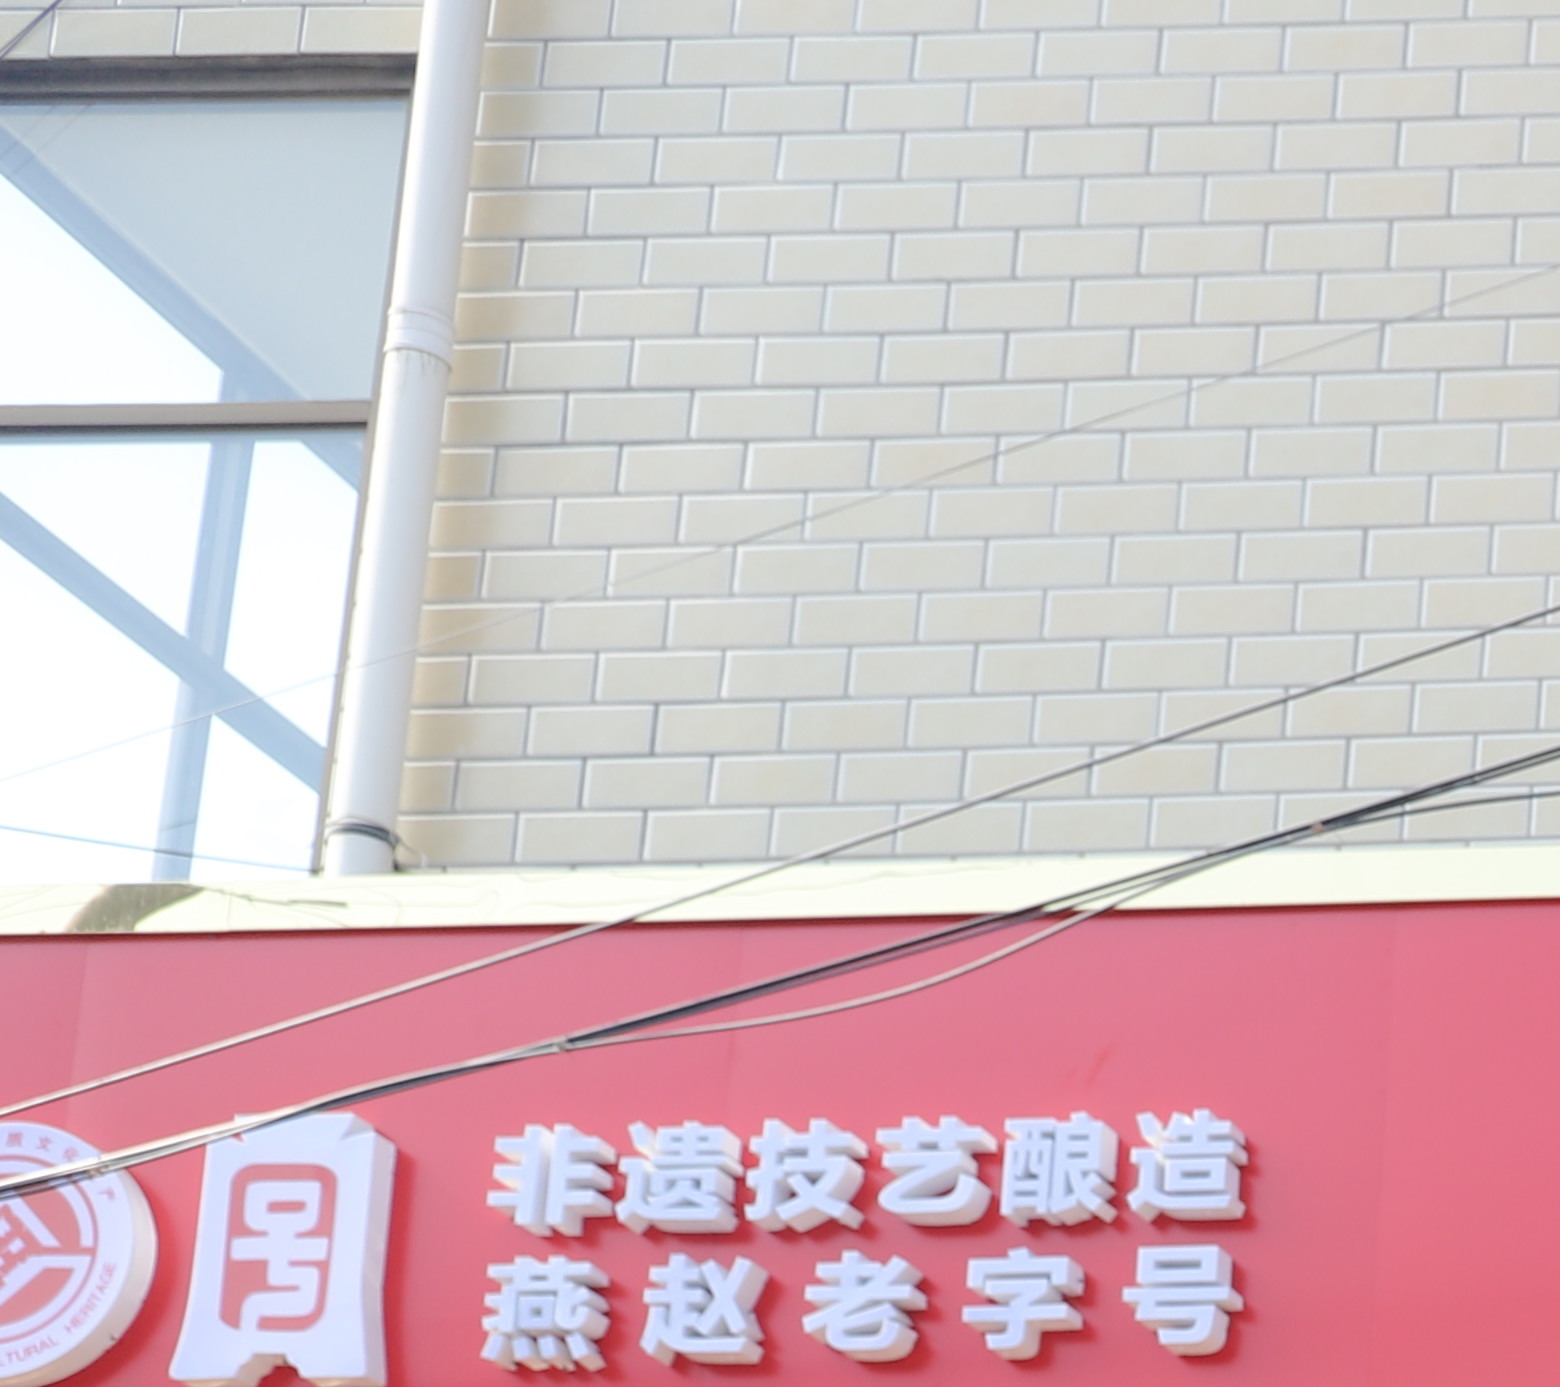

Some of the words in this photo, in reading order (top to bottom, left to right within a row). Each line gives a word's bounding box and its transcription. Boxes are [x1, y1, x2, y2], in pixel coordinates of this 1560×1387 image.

[487, 1110, 1248, 1237] 非遗技艺酿造
[0, 1336, 59, 1367] TURAL
[481, 1243, 1245, 1373] 燕赵老字号
